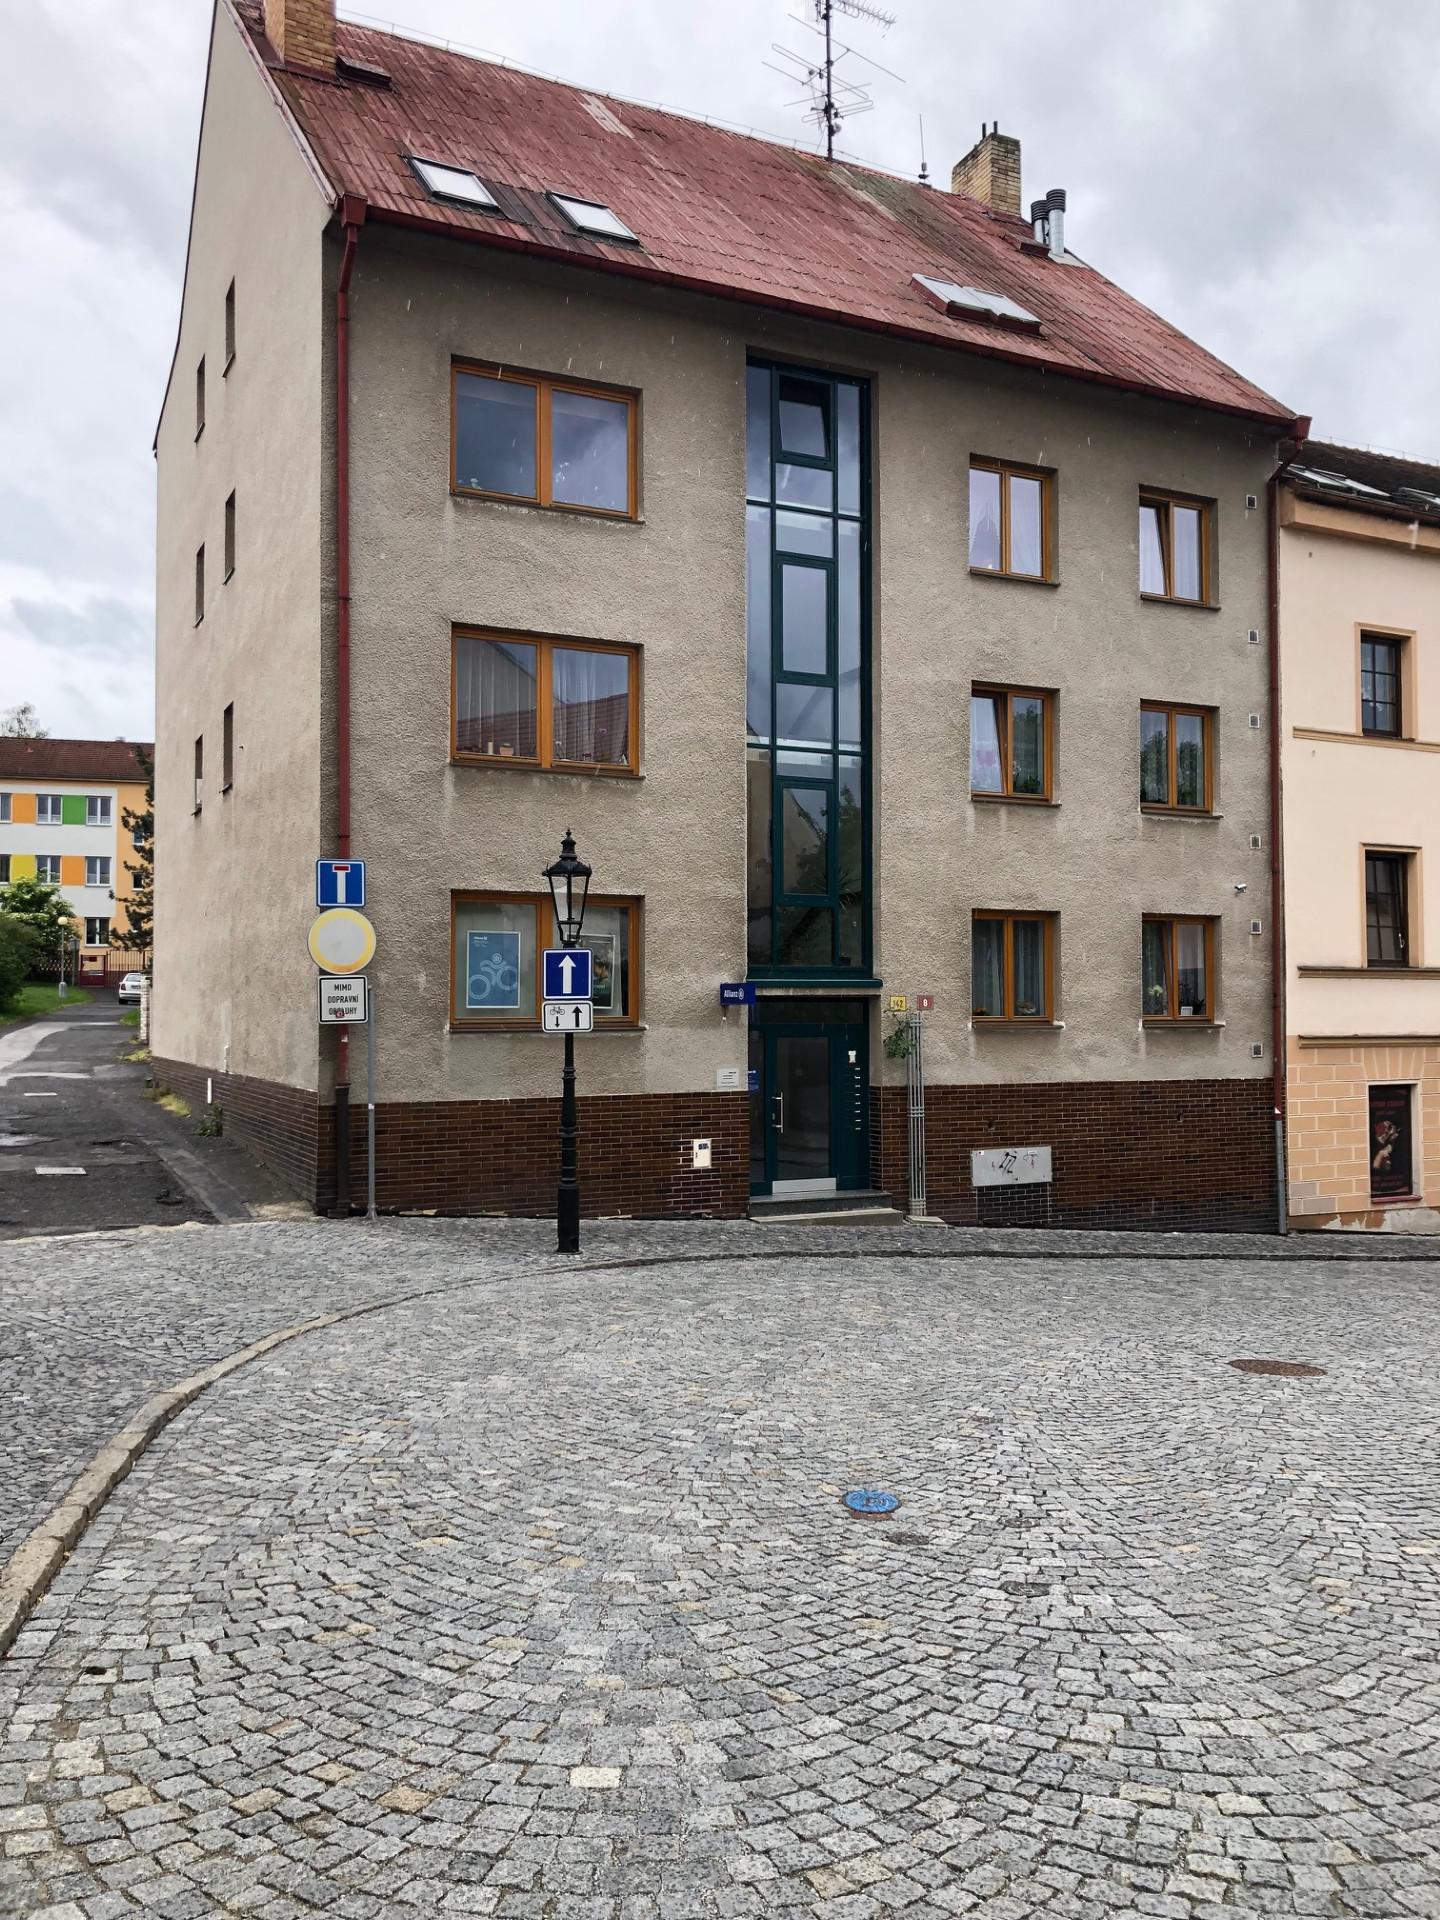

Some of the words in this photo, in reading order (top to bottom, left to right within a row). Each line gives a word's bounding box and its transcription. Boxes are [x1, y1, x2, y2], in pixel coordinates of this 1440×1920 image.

[334, 983, 352, 991] MIMO
[724, 990, 738, 998] Allianz
[327, 994, 359, 1004] DOPRAVNÍ
[923, 998, 928, 1007] 8
